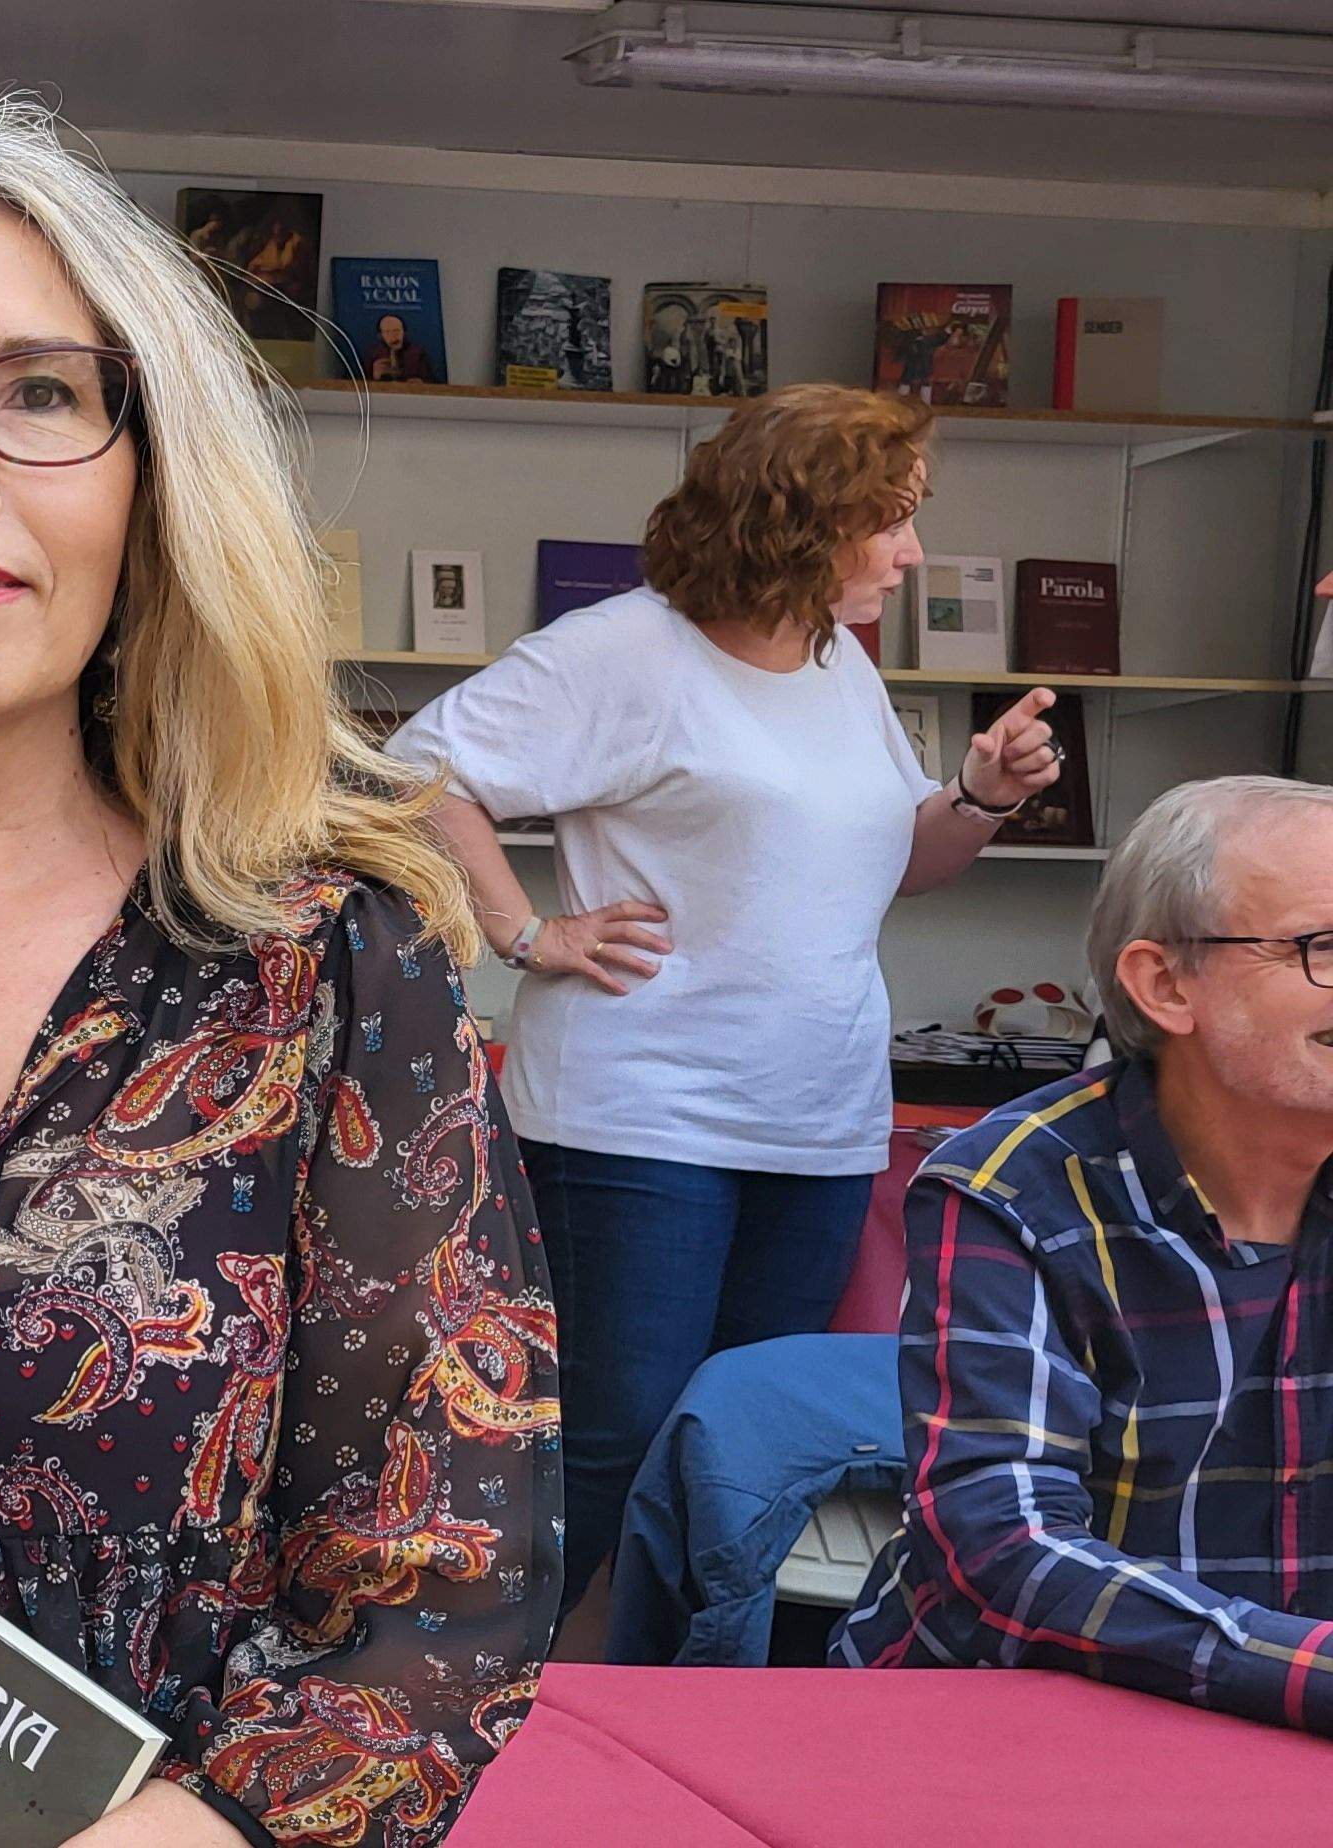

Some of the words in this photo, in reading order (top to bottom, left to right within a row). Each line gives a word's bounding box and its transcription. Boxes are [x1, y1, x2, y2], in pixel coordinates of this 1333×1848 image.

[360, 272, 420, 288] RAMÓN
[951, 301, 990, 318] Goya
[1040, 576, 1106, 600] Parola
